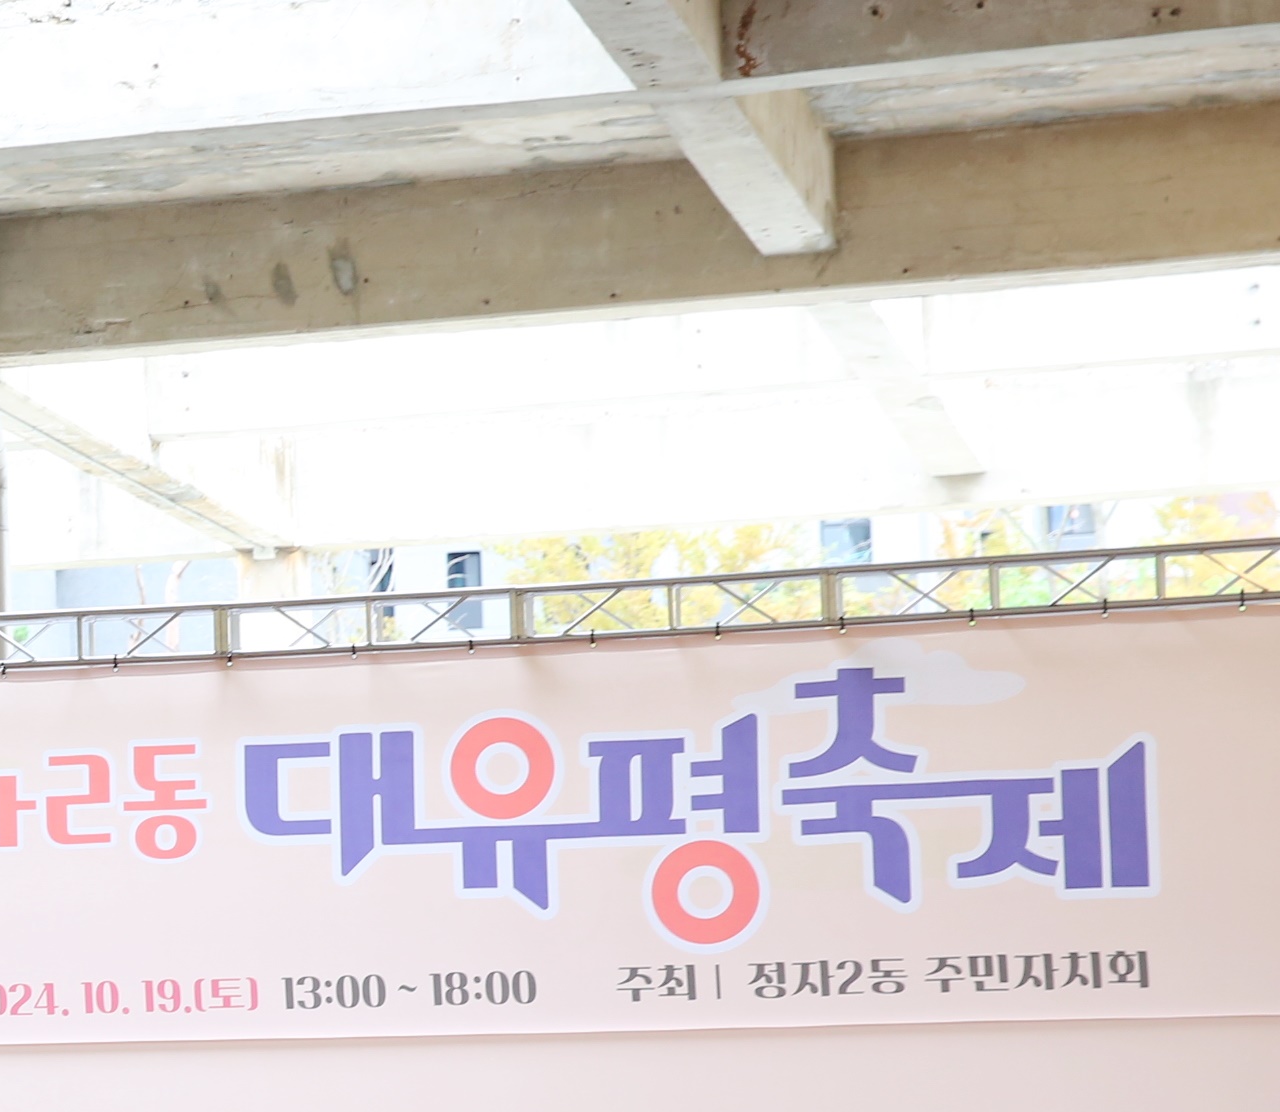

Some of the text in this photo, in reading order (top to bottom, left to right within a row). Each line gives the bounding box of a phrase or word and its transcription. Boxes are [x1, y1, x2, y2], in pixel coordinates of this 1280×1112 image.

[243, 666, 1151, 945] 대유평축제
[80, 979, 130, 1014] 10.
[281, 973, 387, 1011] 13:00
[428, 970, 537, 1006] 18:00
[615, 950, 1150, 1003] 주최 정자2동 주민자치회
